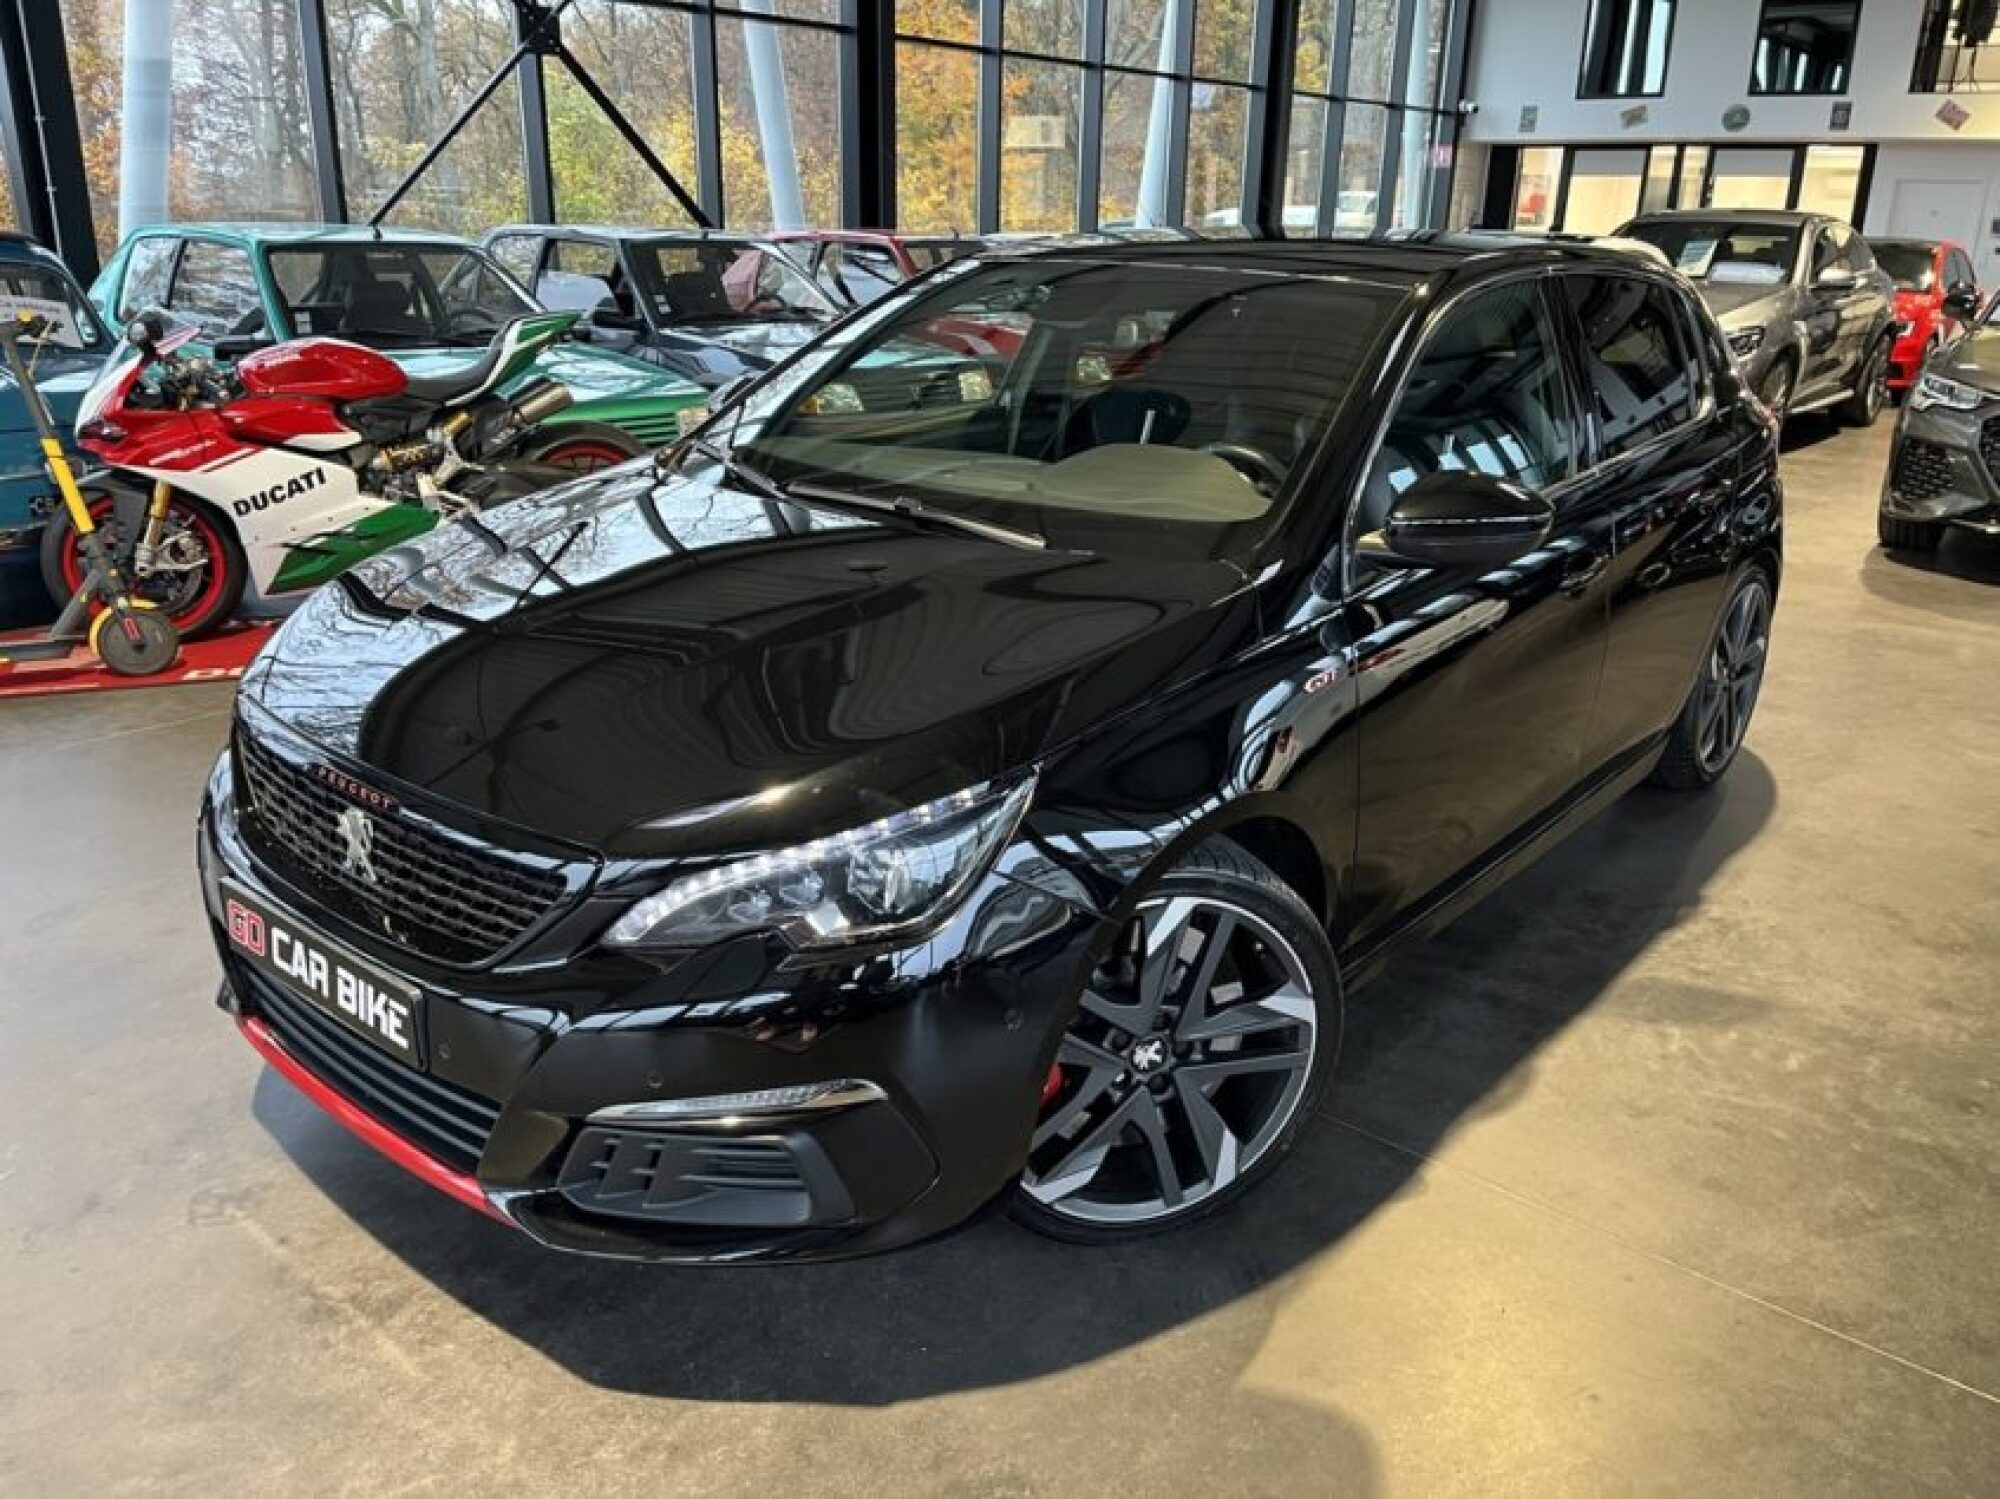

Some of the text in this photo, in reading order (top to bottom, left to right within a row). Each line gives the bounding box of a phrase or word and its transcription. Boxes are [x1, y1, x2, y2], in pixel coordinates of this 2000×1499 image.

[233, 467, 327, 516] DUCATI
[226, 898, 409, 1050] GO CAR BIKE
